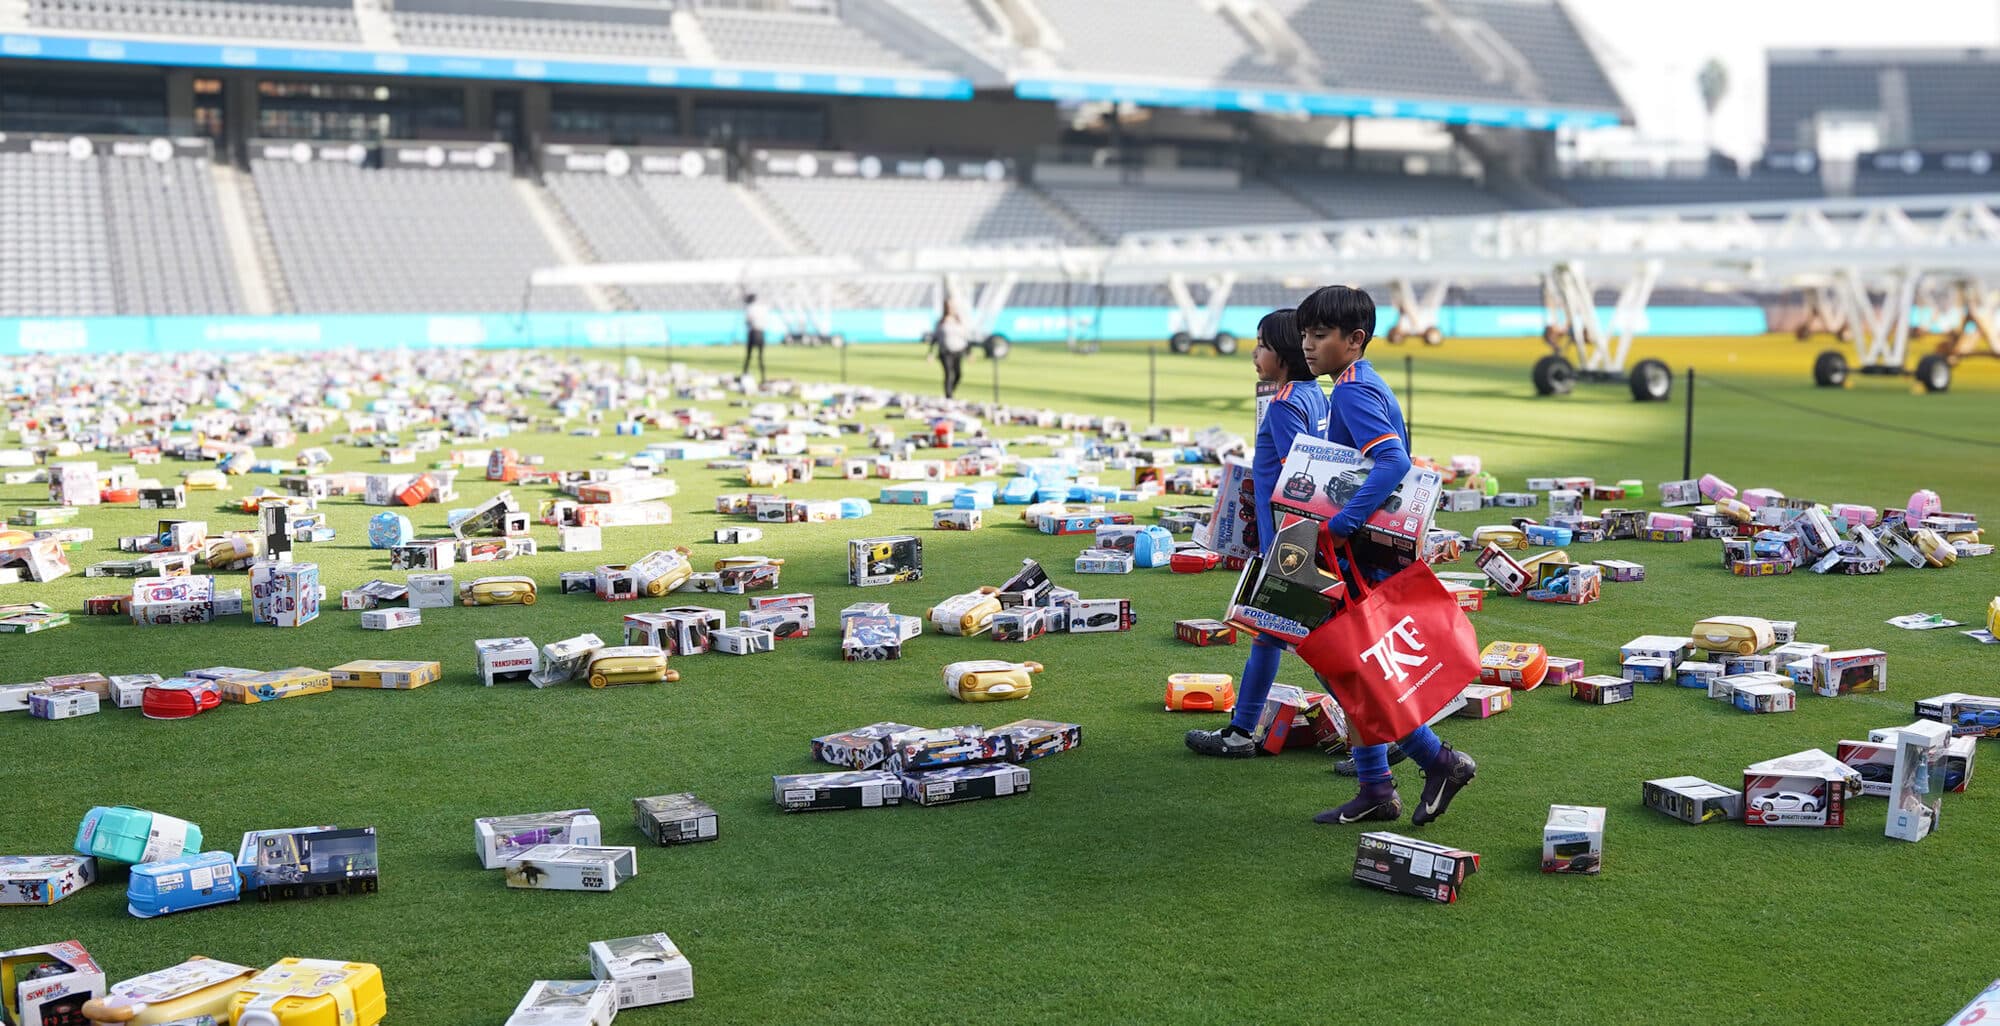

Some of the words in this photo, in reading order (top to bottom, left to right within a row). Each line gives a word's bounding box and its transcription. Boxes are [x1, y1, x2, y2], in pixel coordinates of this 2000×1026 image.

[1294, 442, 1322, 455] FORD
[1243, 608, 1270, 621] FORD
[1360, 615, 1428, 683] TKF
[491, 658, 533, 668] TRANSFORMERS
